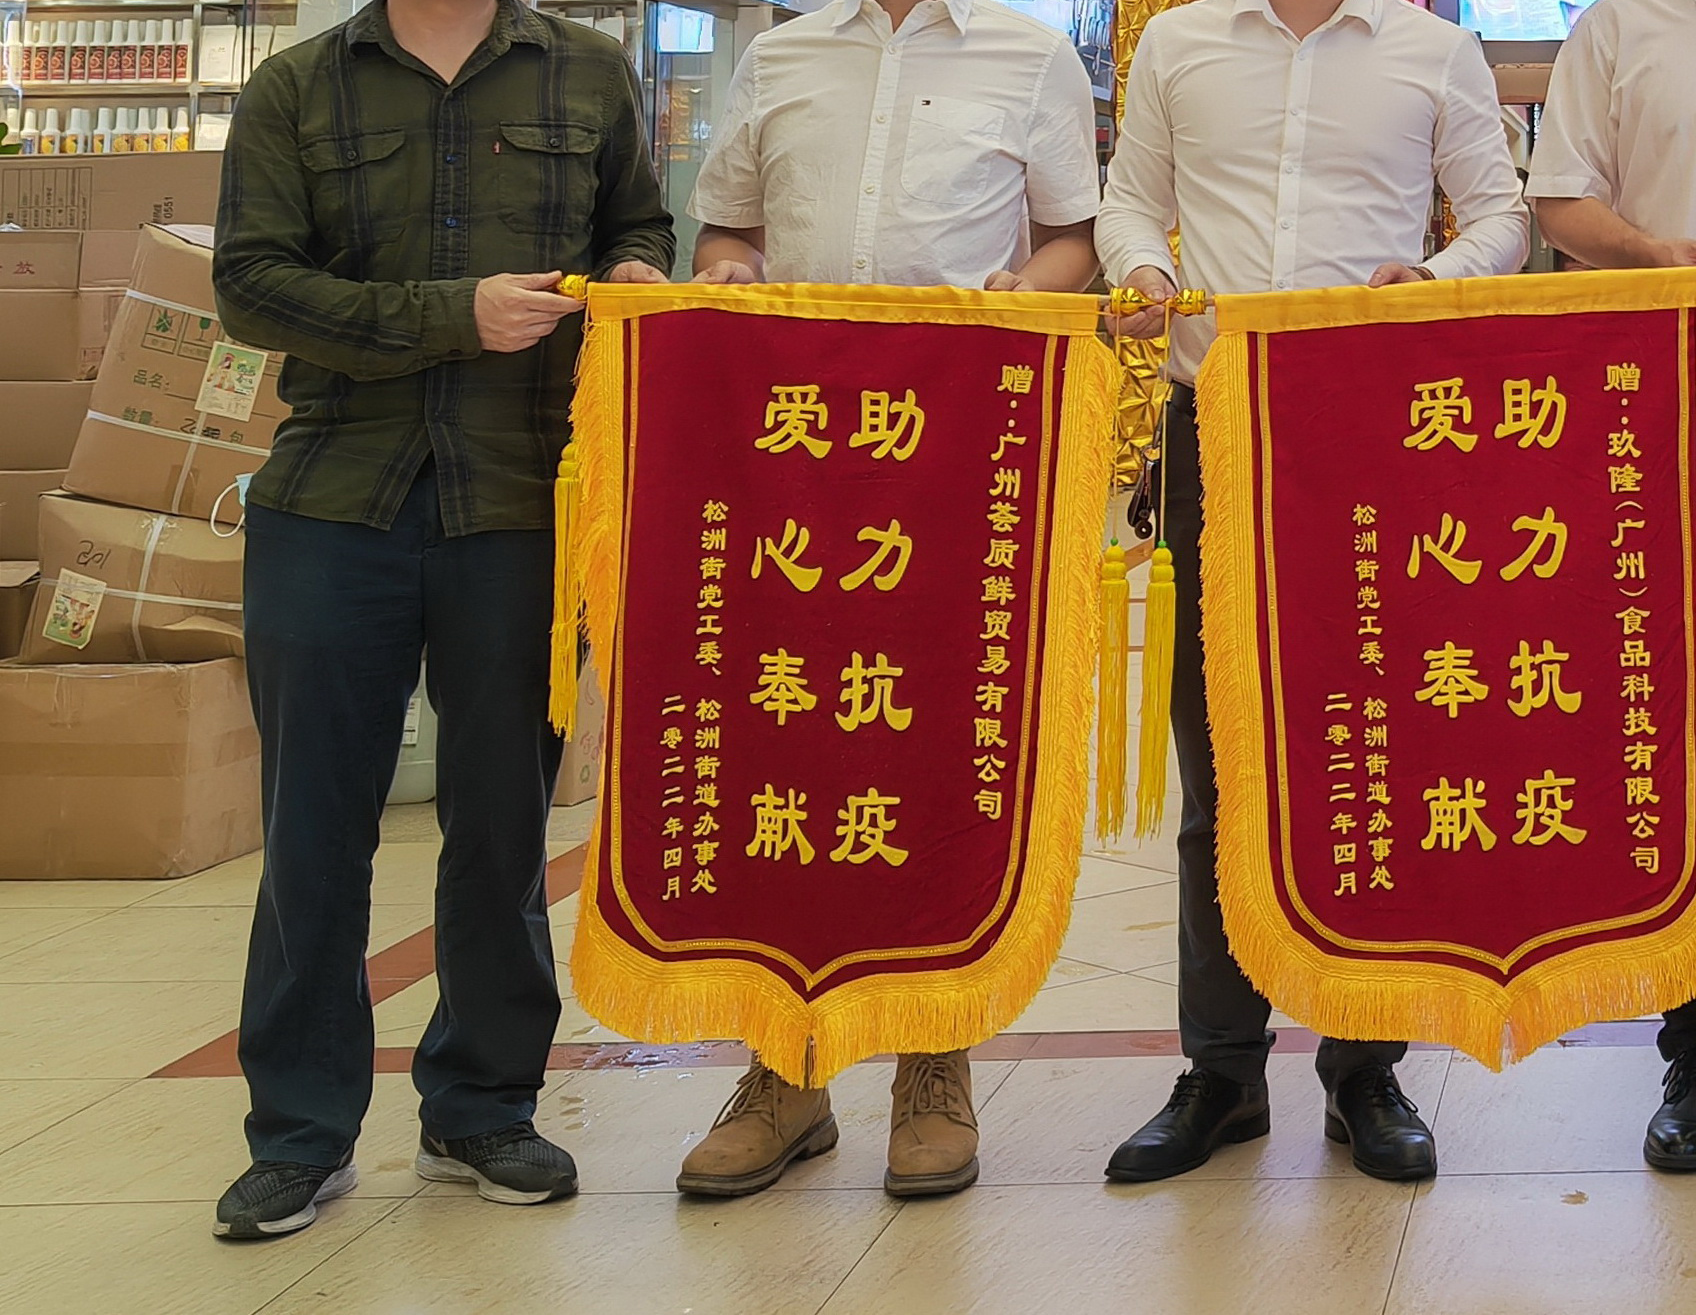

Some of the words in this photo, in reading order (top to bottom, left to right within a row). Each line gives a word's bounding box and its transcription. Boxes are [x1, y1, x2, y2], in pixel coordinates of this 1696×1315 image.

[660, 695, 685, 900] 二零二二年四月
[746, 384, 834, 866] 爱心奉献
[829, 388, 926, 866] 助力抗疫
[1324, 693, 1356, 895] 二零二二年四月
[1402, 376, 1497, 852] 爱心奉献
[1494, 375, 1587, 847] 助力抗疫
